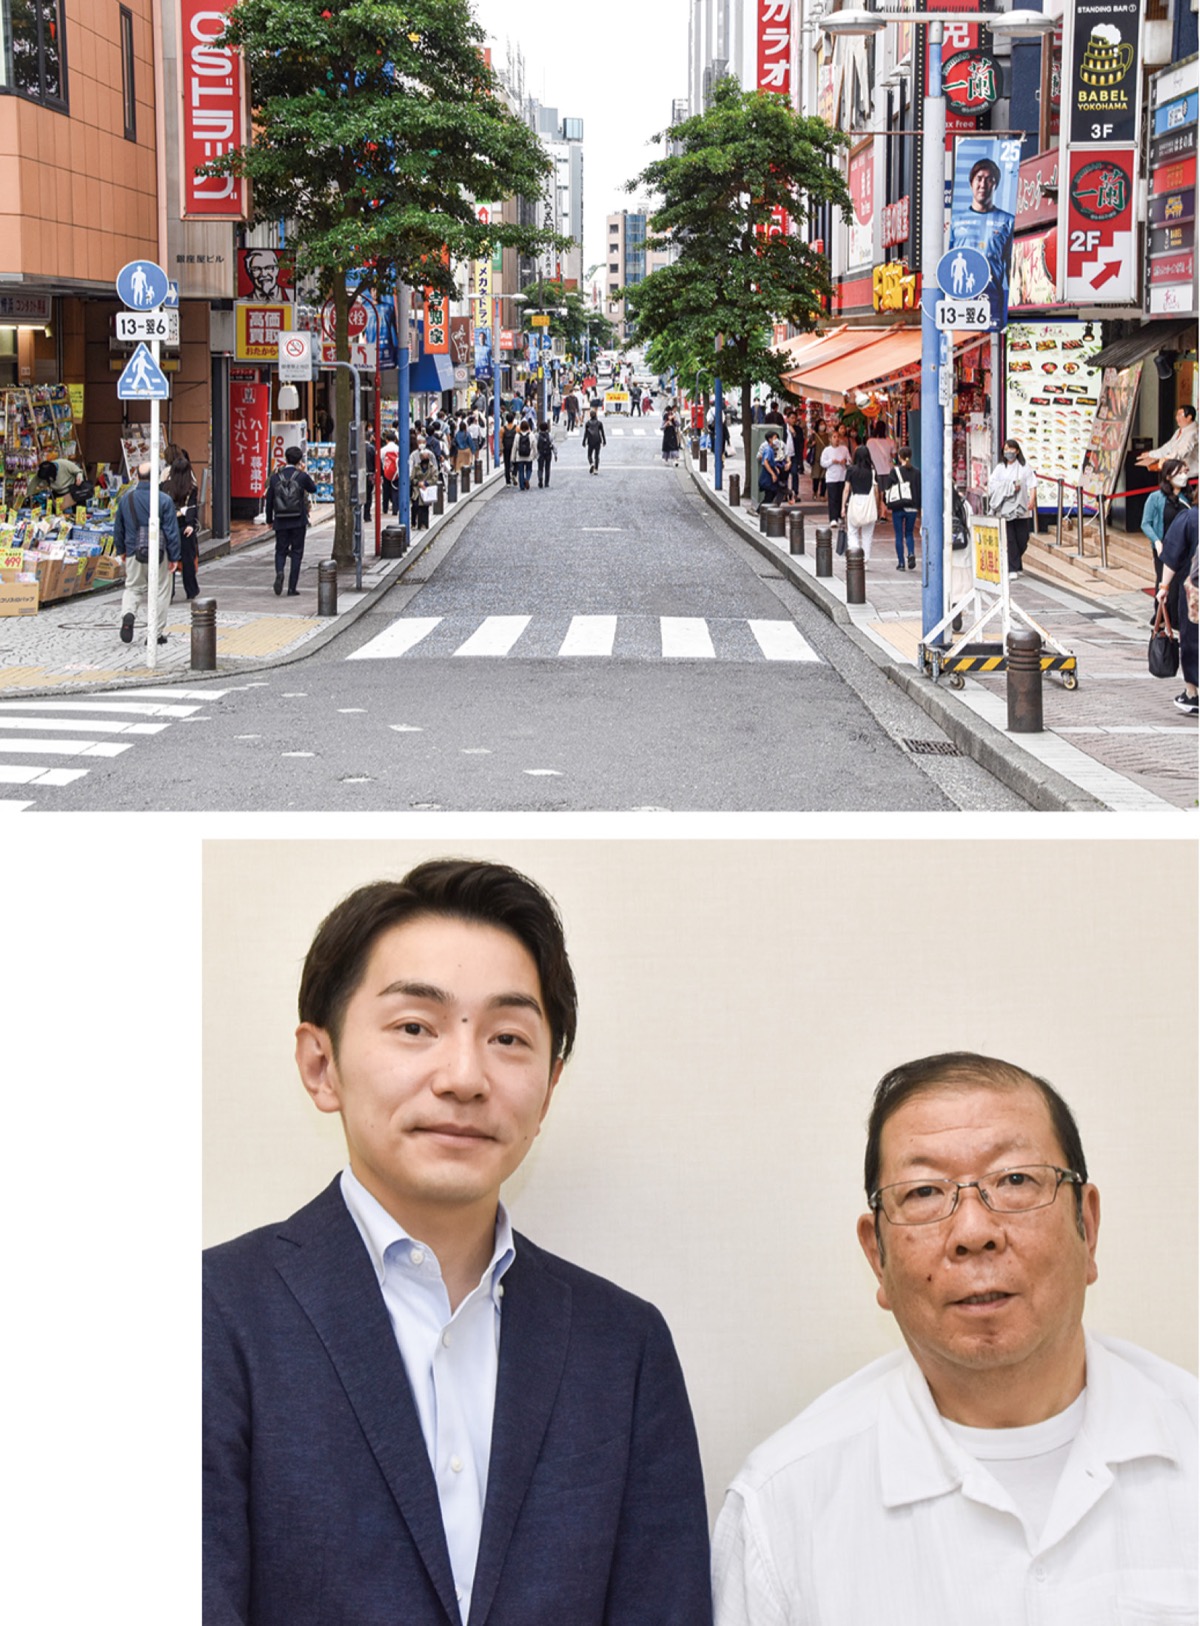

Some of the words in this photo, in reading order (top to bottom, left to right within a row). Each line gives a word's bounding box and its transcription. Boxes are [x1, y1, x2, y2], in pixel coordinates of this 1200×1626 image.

[1077, 5, 1112, 14] STANDING
[760, 0, 790, 91] カラオ
[941, 57, 997, 101] 一蘭
[1078, 89, 1128, 102] BABEL
[1077, 102, 1128, 111] YOKOHAMA
[945, 120, 953, 128] ax
[955, 119, 975, 128] Free
[1090, 124, 1114, 139] 3F
[1000, 141, 1021, 162] 25
[1072, 168, 1125, 211] 一蘭
[1069, 230, 1101, 252] 2F
[176, 254, 225, 264] 銀座屋ビル
[249, 311, 281, 328] 高価
[940, 306, 987, 325] 13-翌6
[121, 318, 166, 335] 13-翌6
[245, 346, 279, 356] おたから
